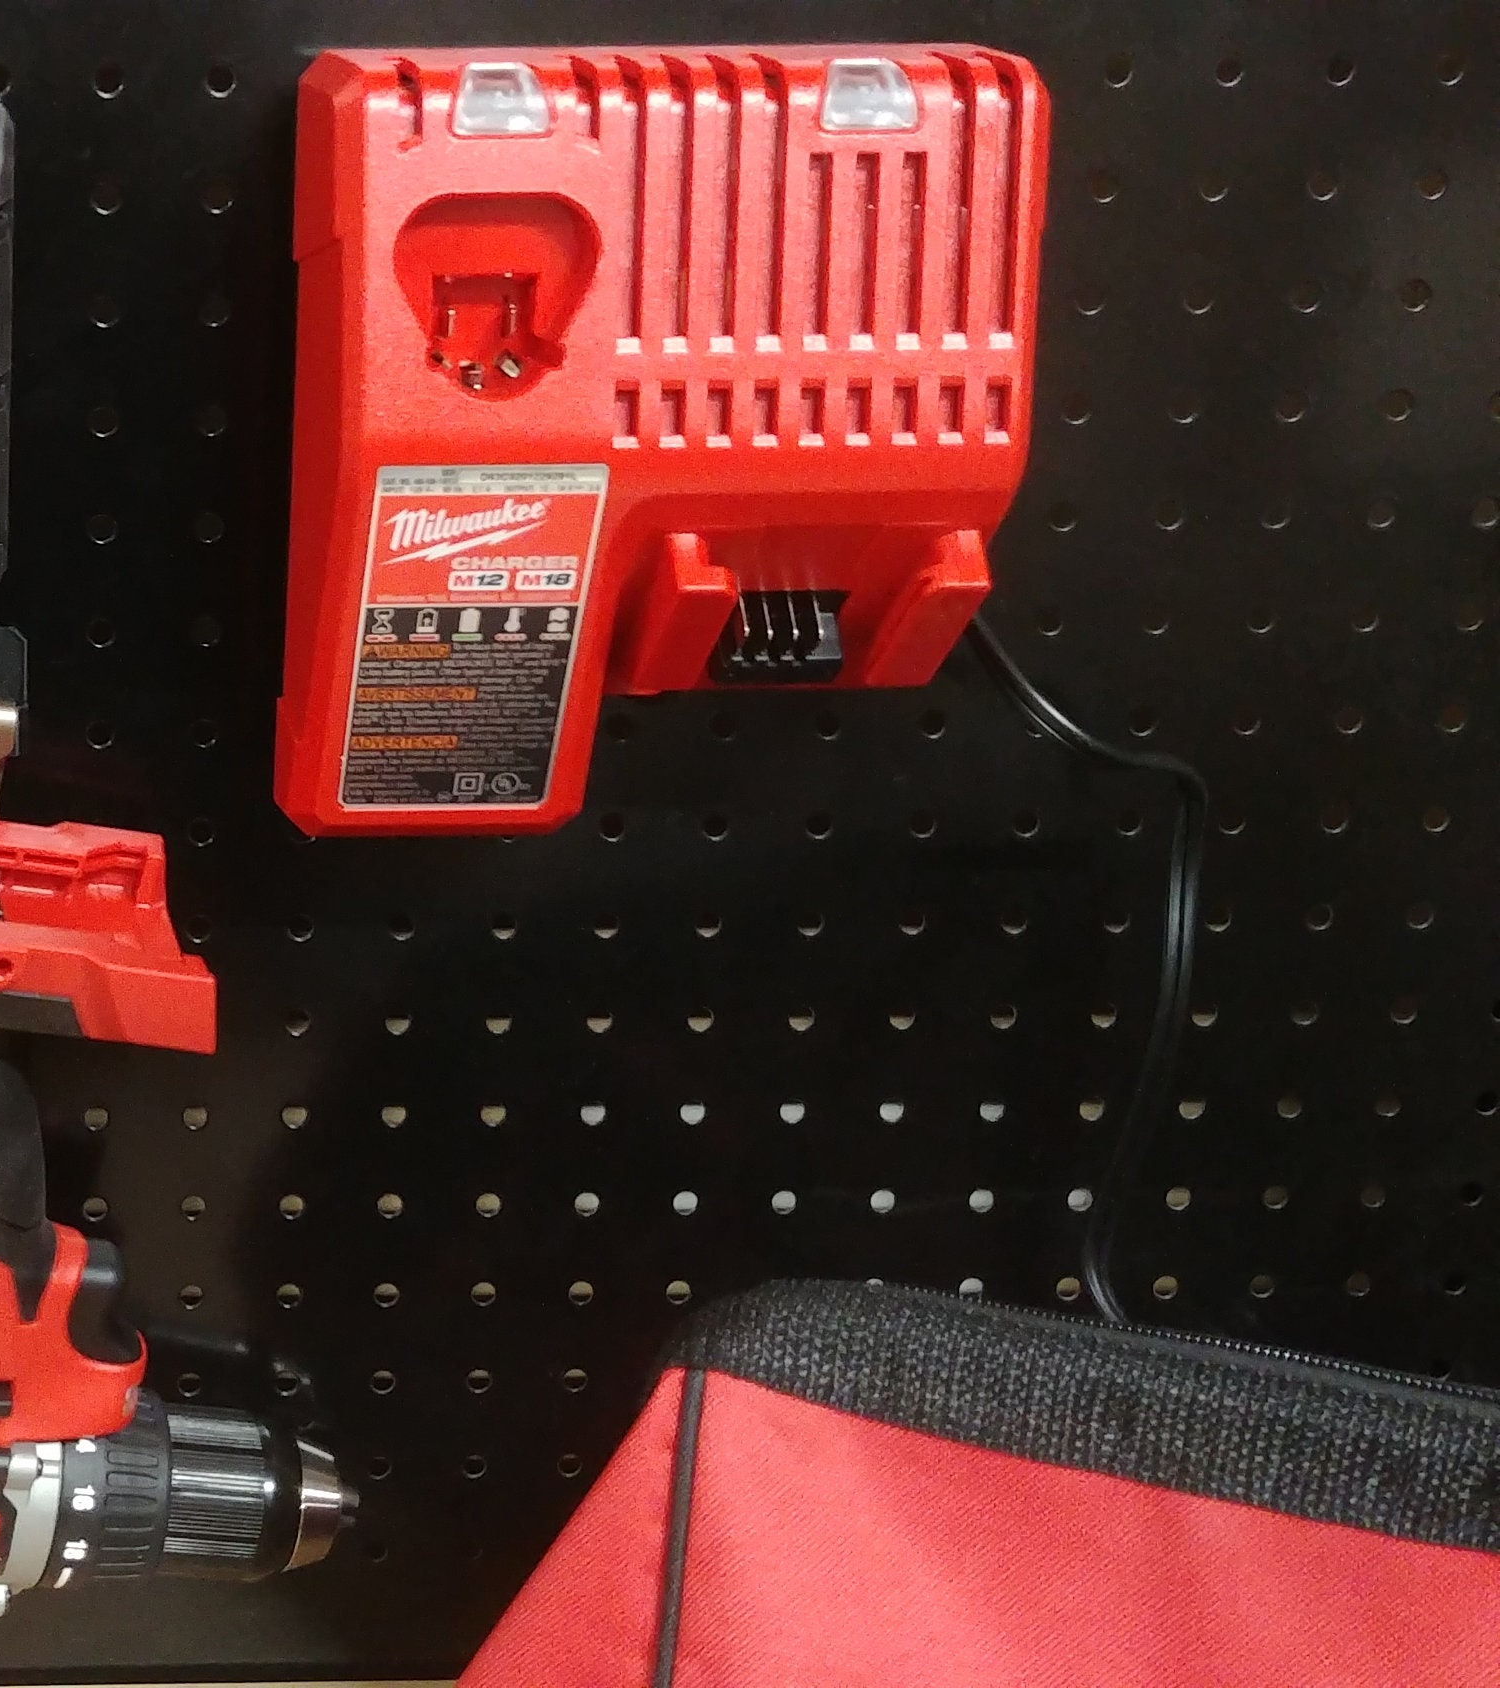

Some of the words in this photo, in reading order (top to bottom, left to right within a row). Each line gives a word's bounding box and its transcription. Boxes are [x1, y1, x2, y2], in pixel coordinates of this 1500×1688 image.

[384, 498, 546, 551] Milwaukee
[450, 555, 579, 570] CHARGER
[453, 572, 504, 587] M12
[520, 571, 573, 586] M18
[71, 1484, 96, 1511] 16
[62, 1538, 89, 1561] 18
